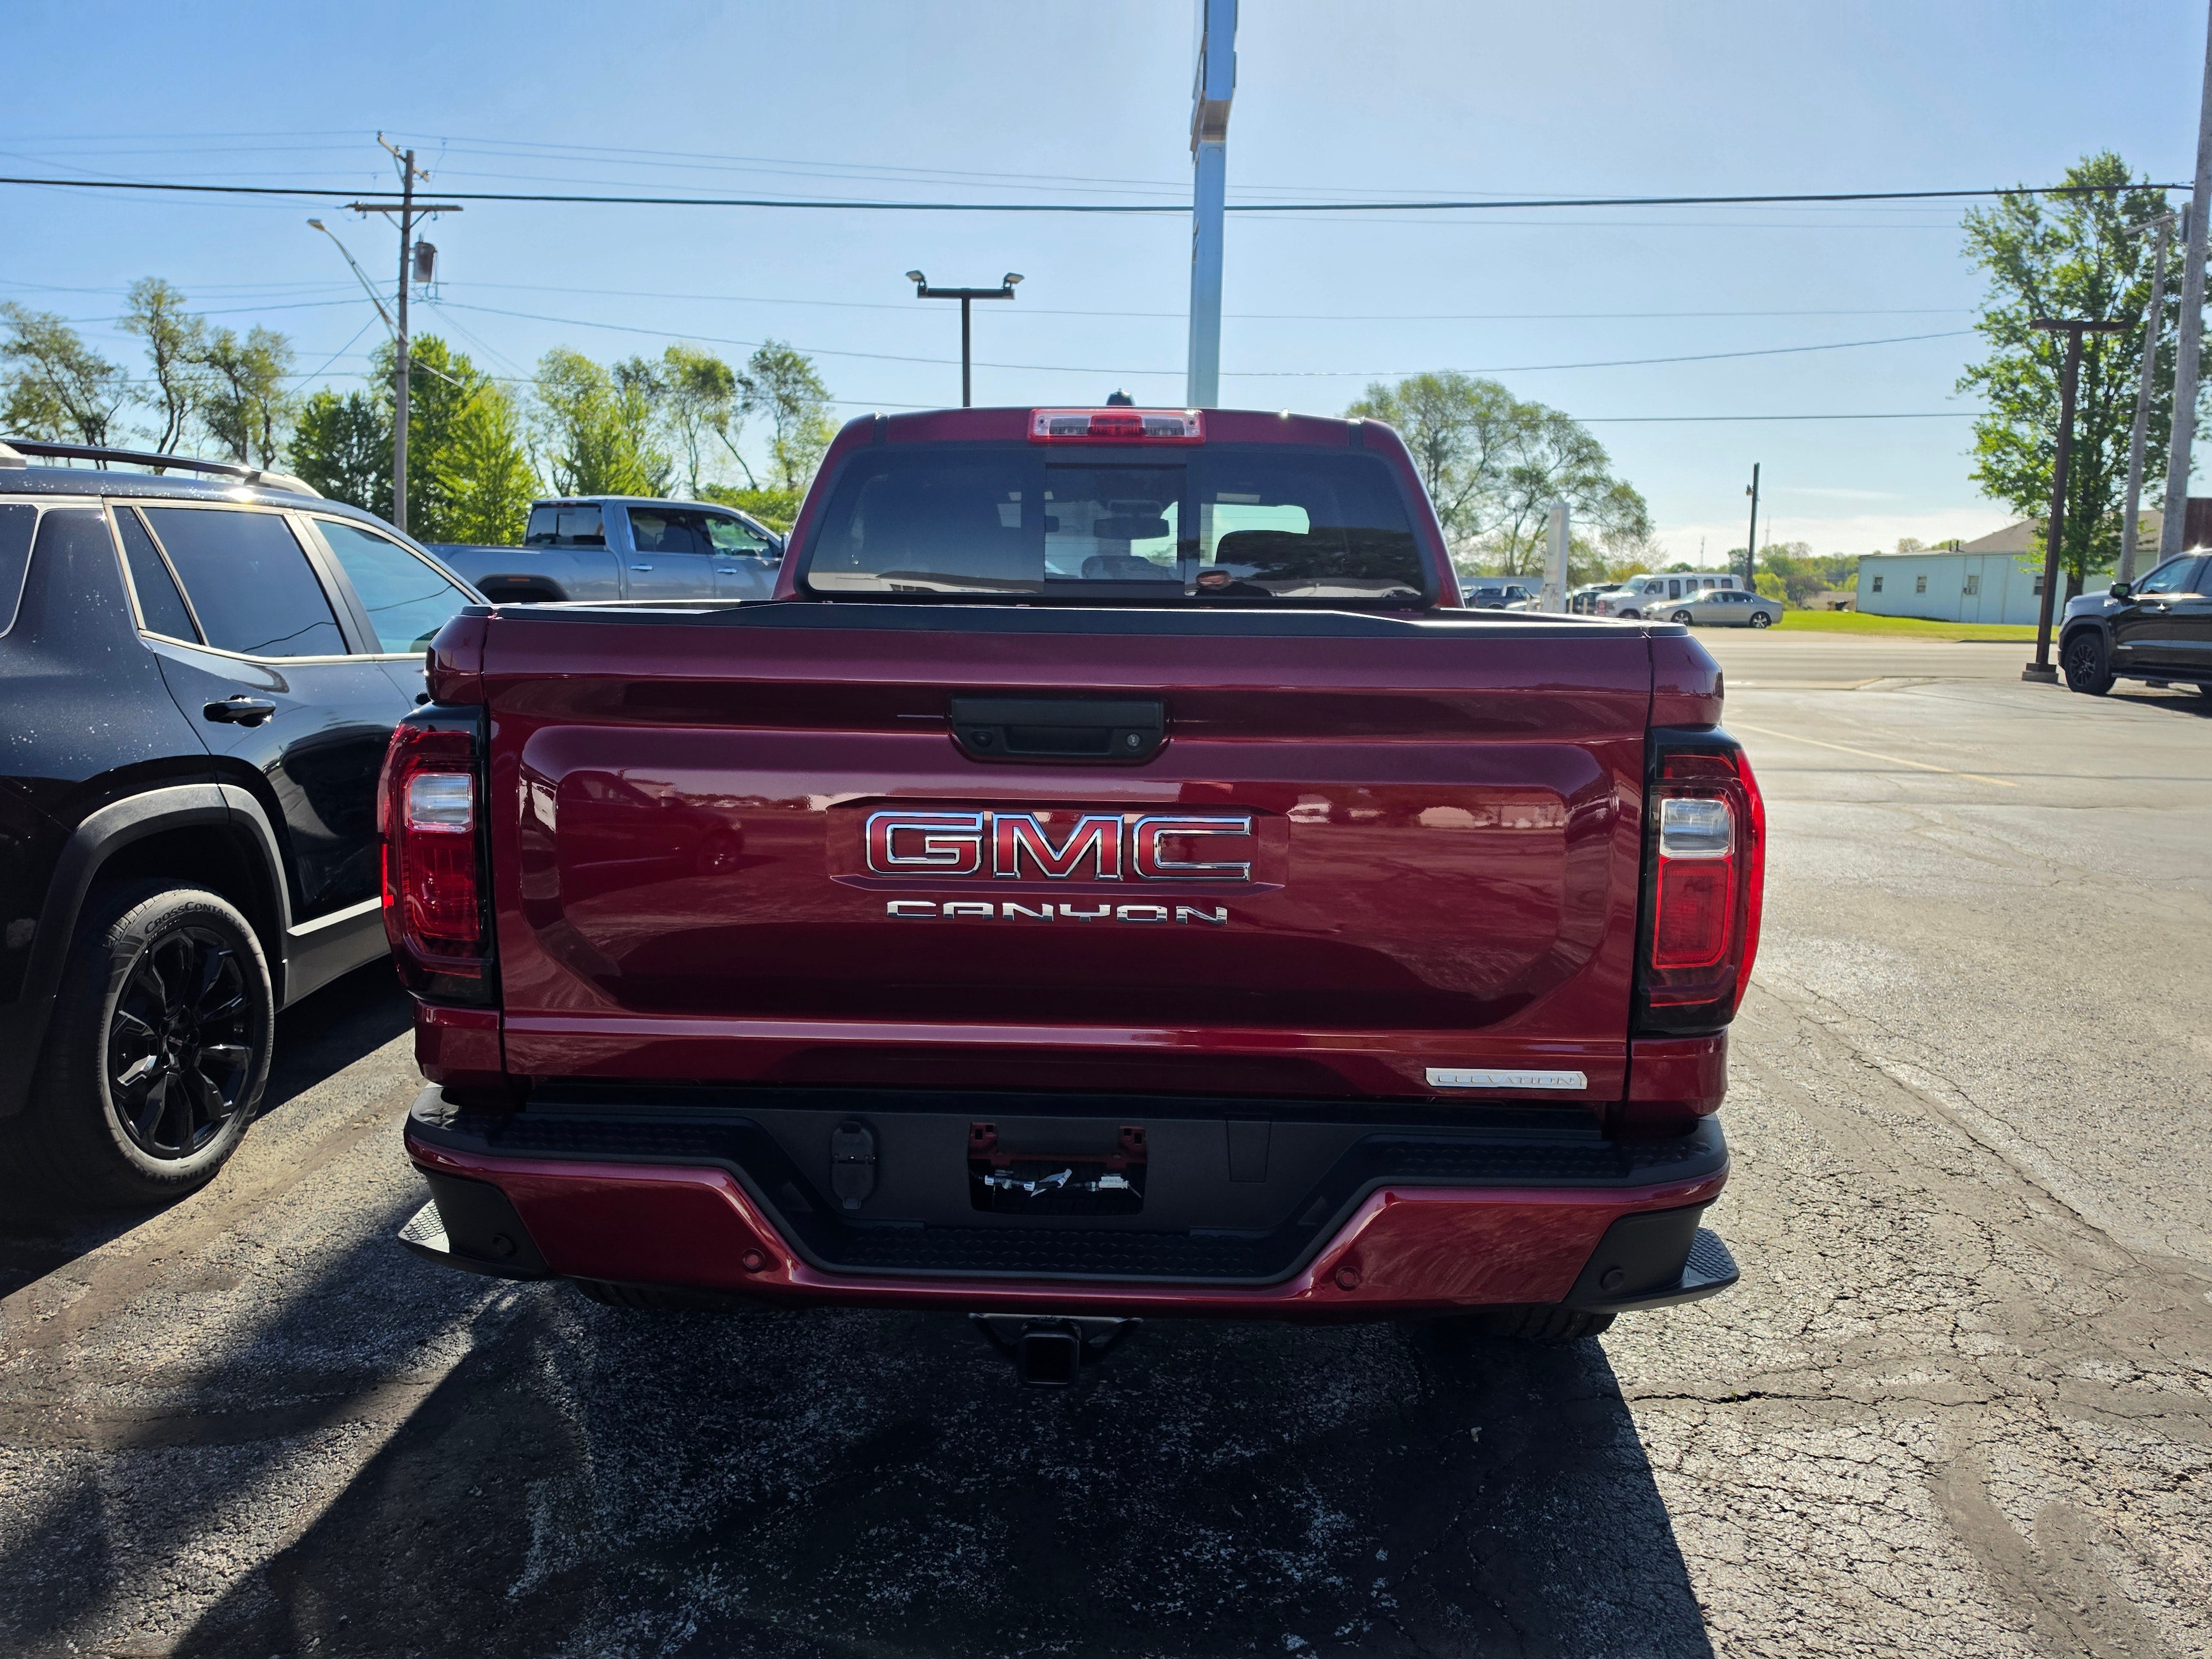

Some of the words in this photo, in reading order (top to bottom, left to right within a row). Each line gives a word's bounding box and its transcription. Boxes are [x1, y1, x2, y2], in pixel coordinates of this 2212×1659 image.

[865, 811, 1253, 881] GMC
[886, 900, 1228, 925] CANYON
[1438, 1074, 1575, 1085] ELEVATION
[137, 1139, 238, 1187] CONTINENT
